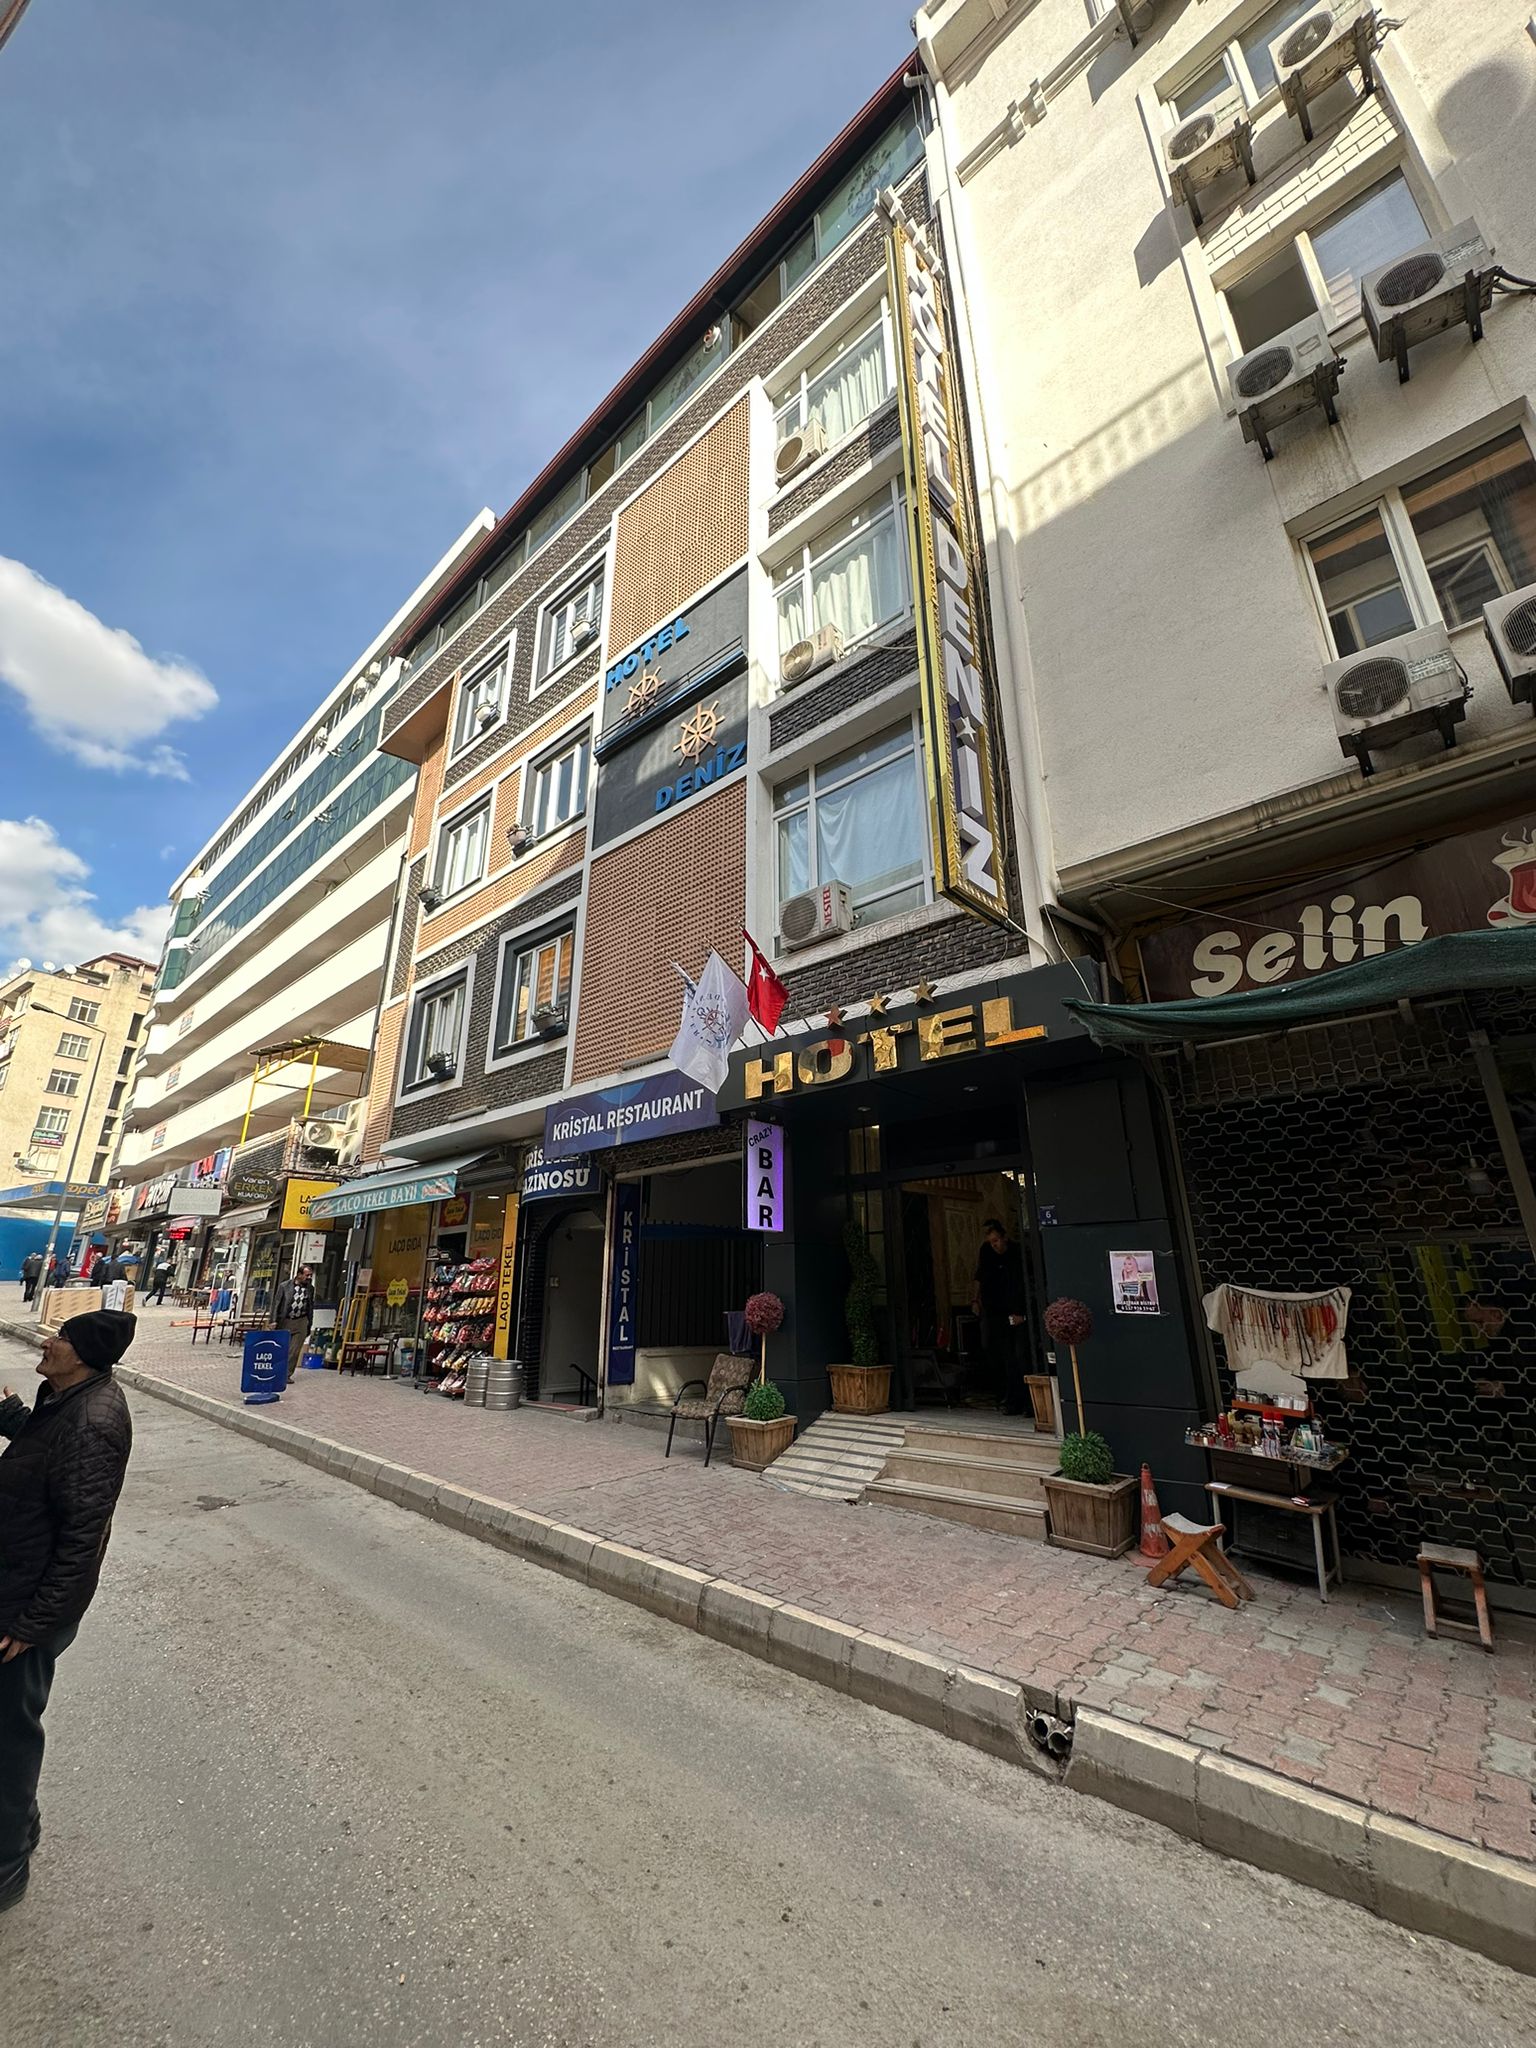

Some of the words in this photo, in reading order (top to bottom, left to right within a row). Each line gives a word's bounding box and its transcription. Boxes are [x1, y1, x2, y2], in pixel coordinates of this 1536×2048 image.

[607, 617, 690, 693] HOTEL
[934, 515, 1000, 898] DENİZ
[655, 741, 746, 812] DENİZ
[823, 886, 832, 927] VESTEL
[1190, 895, 1429, 999] Selin
[744, 996, 1048, 1099] HOTEL
[553, 1115, 604, 1141] KRİSTAL
[607, 1089, 704, 1128] RESTAURANT
[748, 1125, 773, 1147] CRAZY
[234, 1182, 273, 1194] ERKEK
[300, 1195, 316, 1204] LA
[362, 1190, 388, 1209] TEKEL
[757, 1147, 775, 1228] BAR
[388, 1240, 405, 1256] LAÇO
[502, 1241, 514, 1288] TEKEL
[618, 1210, 633, 1342] KRİSTAL
[499, 1292, 510, 1330] LAÇO
[255, 1353, 272, 1362] LAÇO
